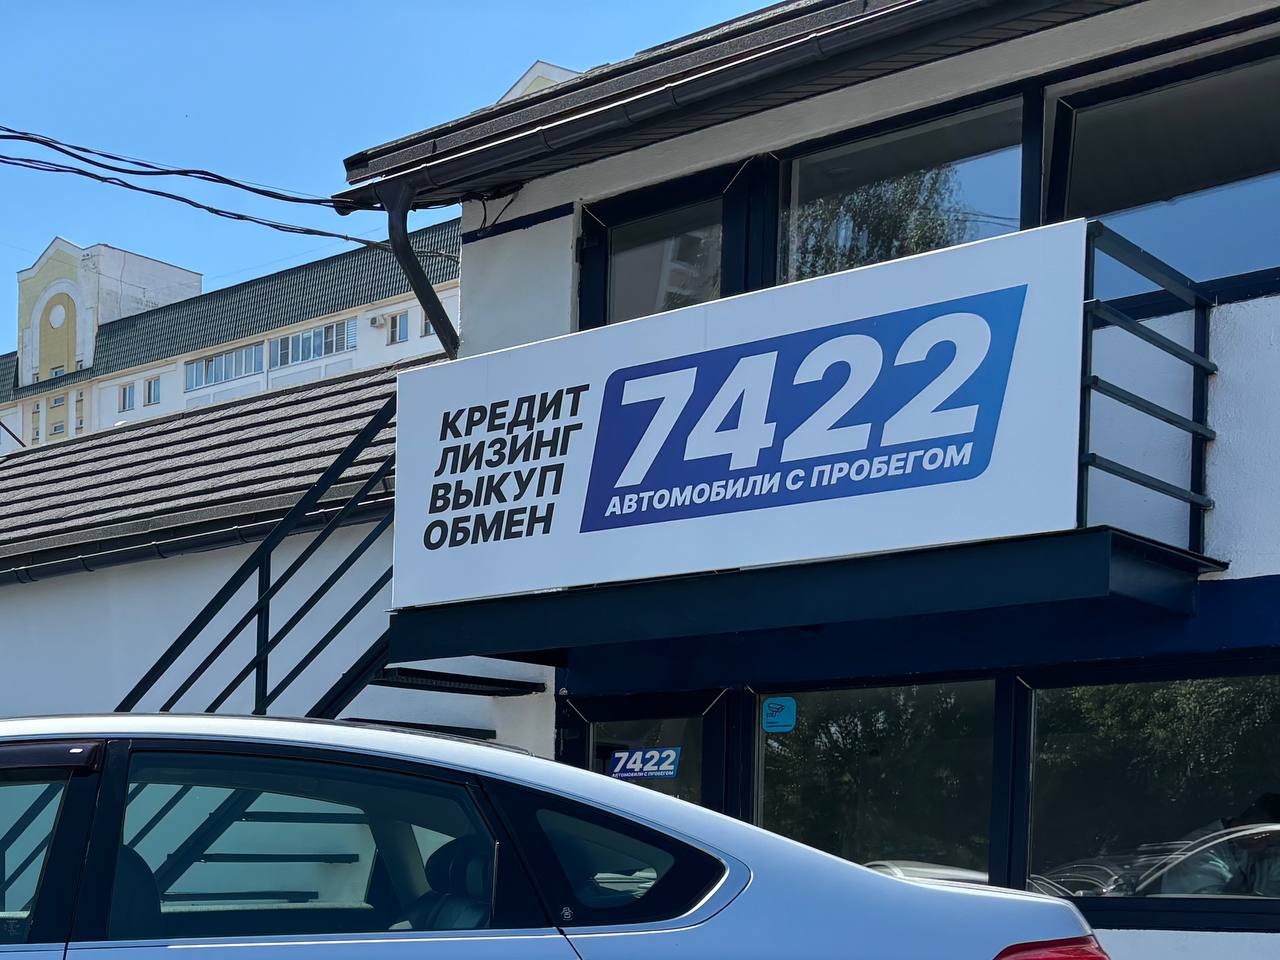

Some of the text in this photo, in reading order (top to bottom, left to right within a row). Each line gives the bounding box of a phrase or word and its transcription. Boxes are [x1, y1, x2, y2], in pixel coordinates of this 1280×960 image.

[439, 383, 591, 441] КРЕДИТ
[613, 312, 992, 489] 7422
[433, 422, 584, 478] ЛИЗИНГ
[428, 462, 565, 515] ВЫКУП
[604, 442, 974, 517] АВТОМОБИЛИ С ПРОБЕГОМ
[423, 502, 556, 551] ОБМЕН
[613, 750, 676, 773] 7422
